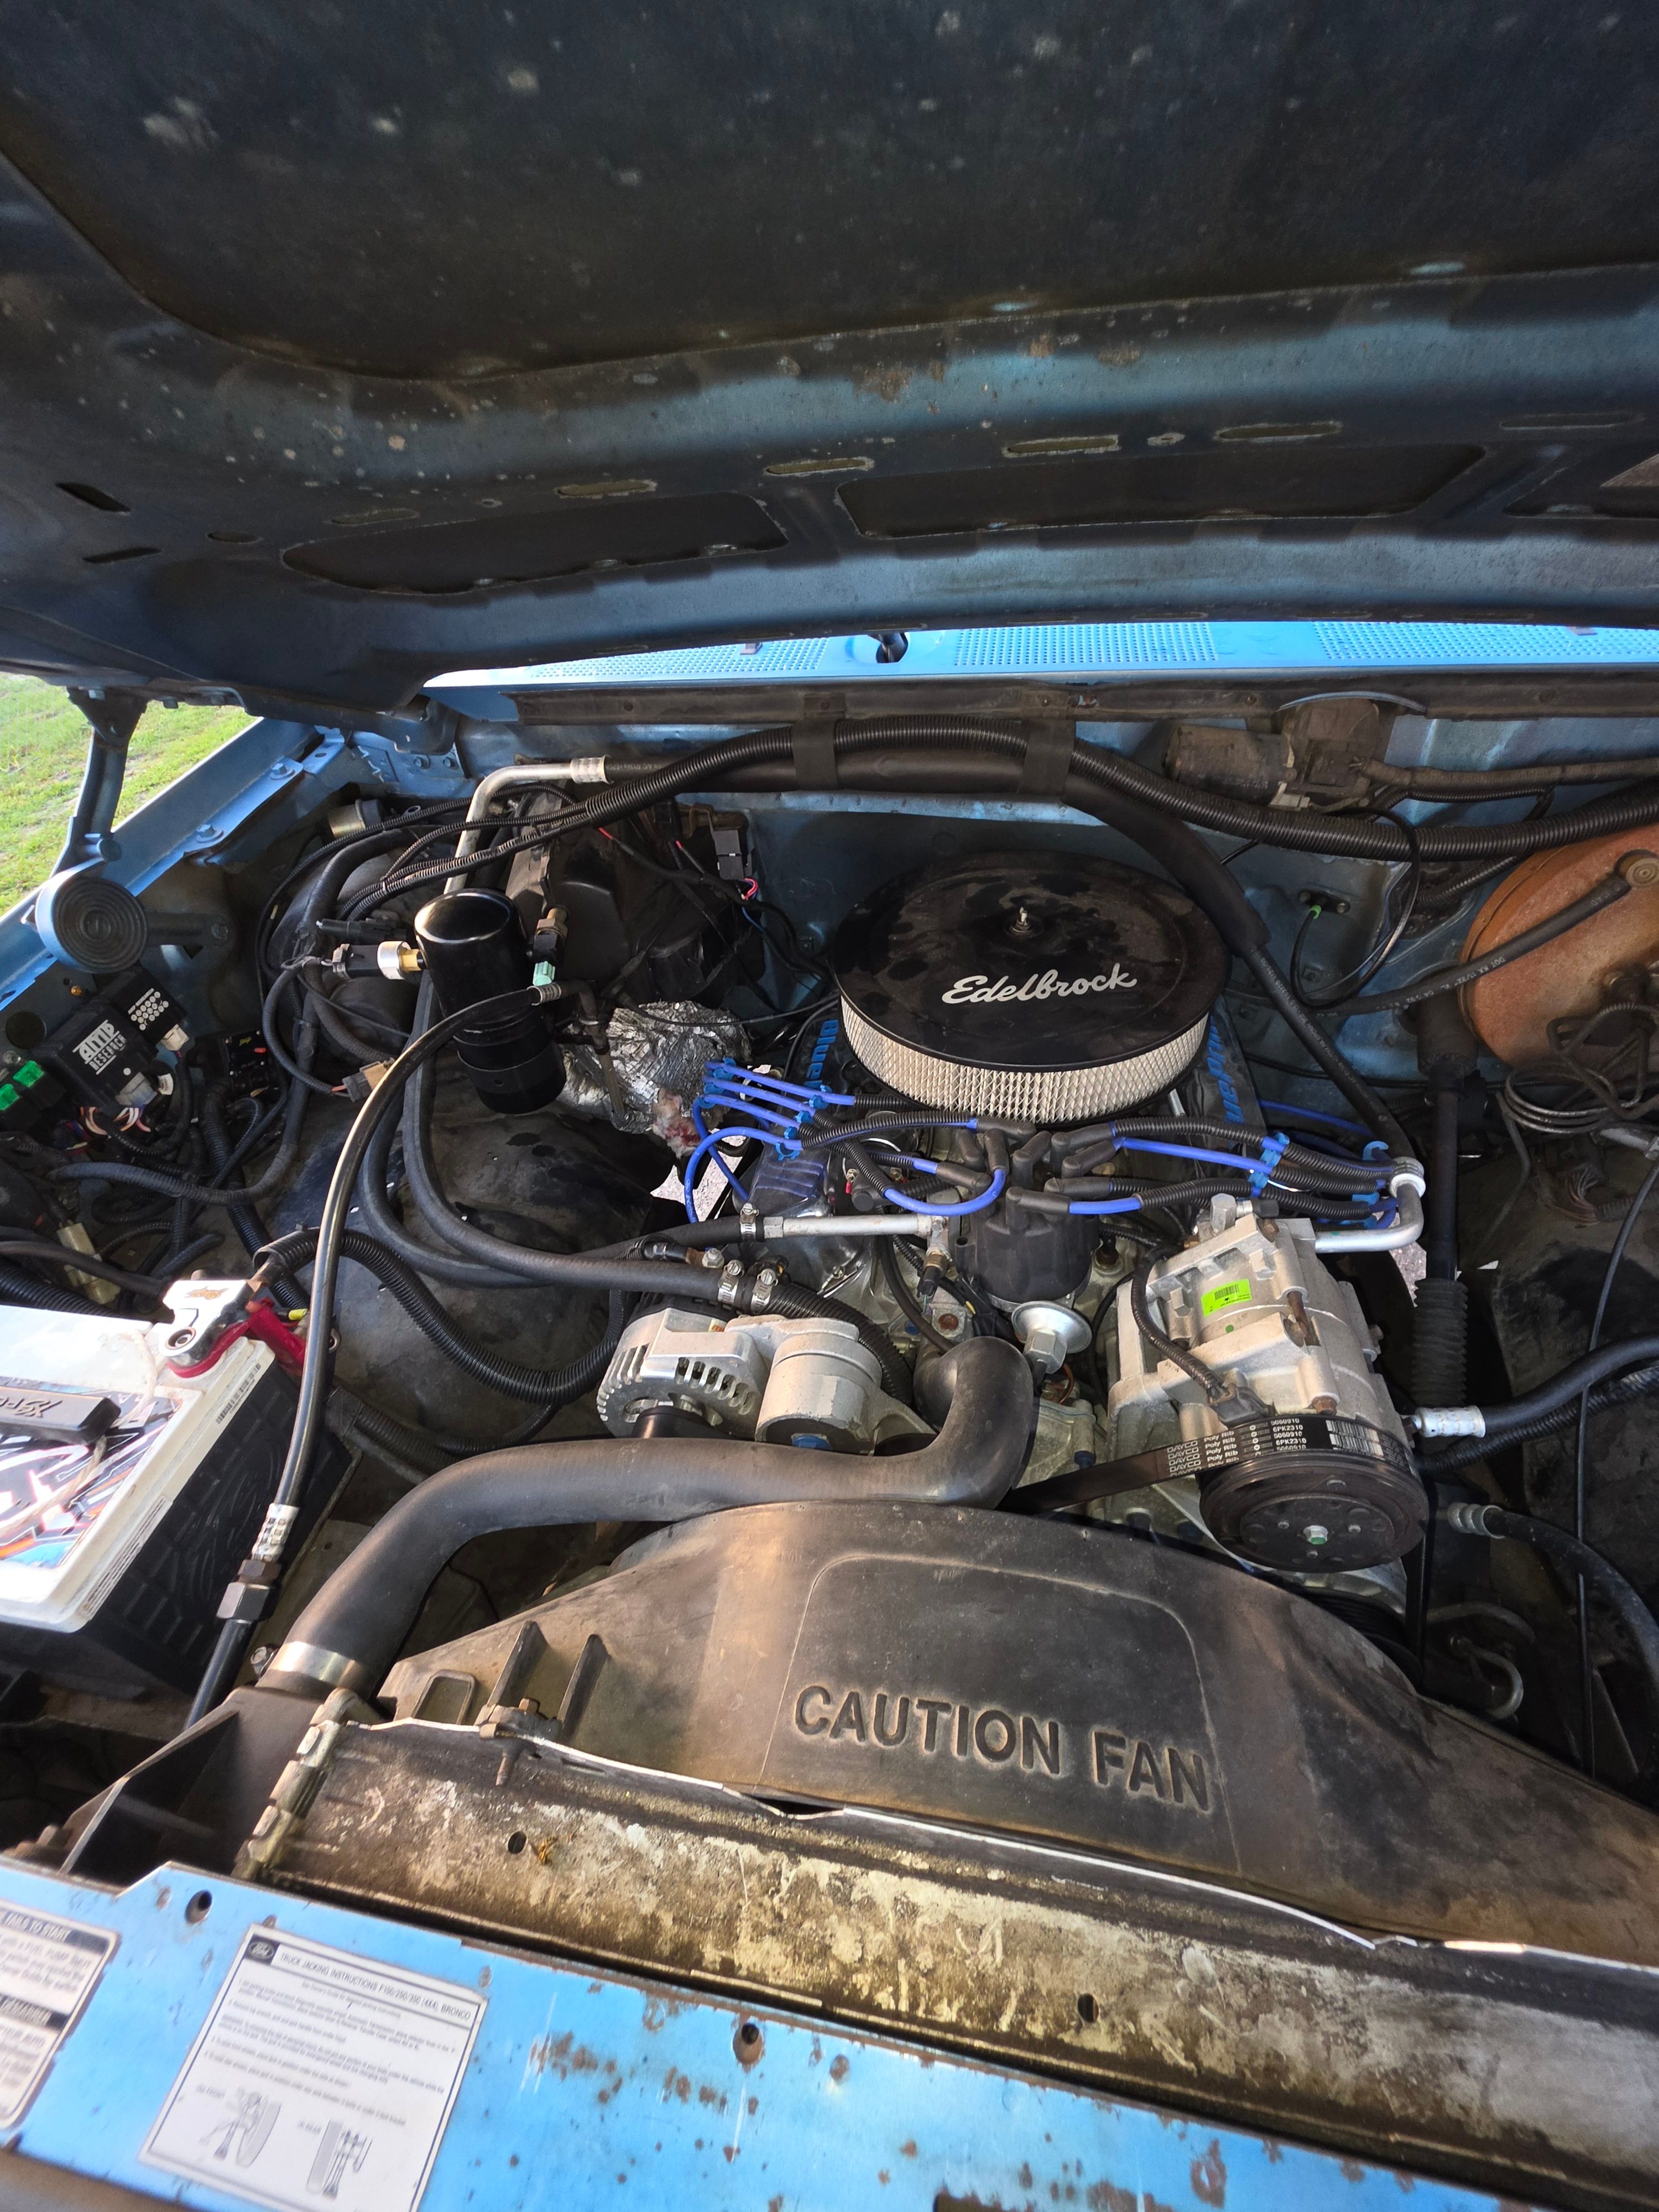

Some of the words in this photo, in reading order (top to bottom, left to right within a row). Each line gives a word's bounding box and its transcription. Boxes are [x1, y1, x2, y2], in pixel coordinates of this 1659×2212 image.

[942, 963, 1137, 1004] Edelbrock
[89, 1033, 127, 1071] RESEARCH
[1167, 1440, 1198, 1453] DAYCO
[1168, 1447, 1199, 1459] DAYCO
[1168, 1453, 1200, 1466] DAYCO
[1170, 1459, 1201, 1473] DAYCO
[795, 1686, 1060, 1774] CAUTION
[1094, 1731, 1209, 1811] FAN
[44, 1923, 71, 1942] START
[280, 1953, 301, 1968] TRUCK
[301, 1959, 328, 1975] JACKING
[330, 1969, 377, 1991] INSTRUCTIONS
[441, 2005, 471, 2021] BRONCO
